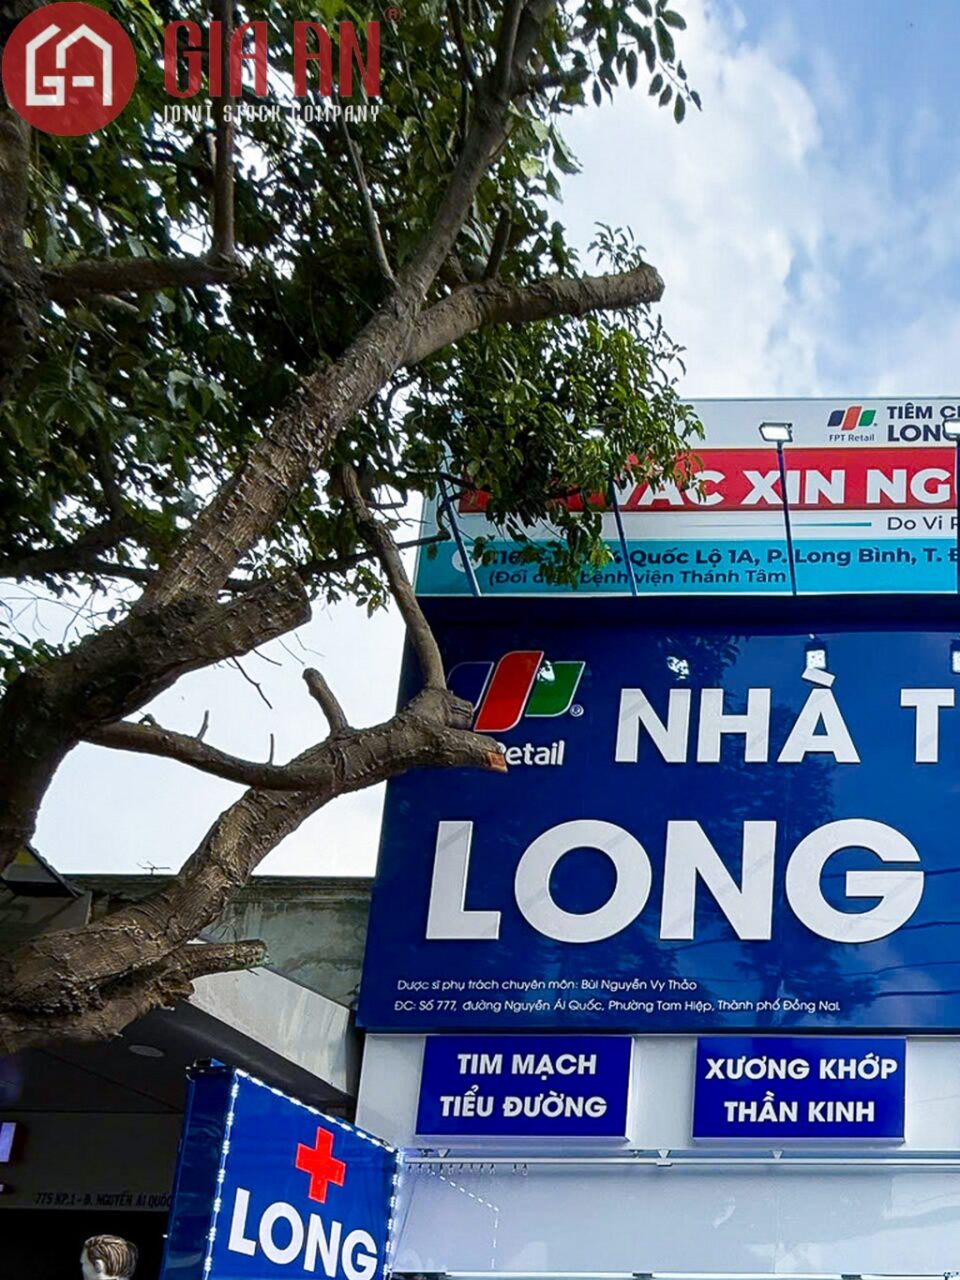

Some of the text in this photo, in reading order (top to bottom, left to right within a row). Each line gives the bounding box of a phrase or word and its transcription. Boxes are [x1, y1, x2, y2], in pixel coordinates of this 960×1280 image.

[887, 402, 933, 419] TIÊM
[829, 433, 875, 442] FPT Retail
[741, 469, 846, 505] XIN
[887, 516, 917, 531] Do
[922, 515, 943, 530] Vi
[629, 547, 692, 566] Quốc
[695, 548, 722, 568] Lộ
[728, 549, 760, 567] 1A,
[767, 549, 788, 564] P.
[795, 549, 851, 566] Long
[858, 546, 917, 566] Bình,
[923, 548, 942, 563] T.
[489, 569, 527, 587] (Đối
[580, 570, 629, 586] bệnh
[636, 570, 674, 586] viện
[679, 569, 740, 584] Thánh
[614, 667, 862, 763] NHÀ
[425, 818, 925, 944] LONG
[397, 979, 430, 991] Dược
[441, 979, 465, 992] phụ
[468, 979, 499, 990] trách
[501, 979, 545, 992] chuyên
[547, 979, 579, 990] môn:
[581, 979, 599, 990] Bùi
[600, 978, 647, 992] Nguyễn
[649, 979, 666, 992] Vy
[668, 978, 698, 991] Thảo
[394, 999, 416, 1011] ĐC:
[418, 998, 434, 1011] Số
[436, 999, 457, 1012] 777,
[462, 999, 501, 1013] đường
[504, 998, 551, 1013] Nguyễn
[553, 998, 566, 1011] Ái
[568, 997, 605, 1012] Quốc,
[608, 999, 654, 1013] Phường
[656, 1000, 682, 1011] Tam
[684, 1000, 715, 1013] Hiệp,
[717, 999, 753, 1011] Thành
[756, 997, 781, 1013] phố
[783, 999, 816, 1013] Đồng
[457, 1053, 598, 1081] TIM MẠCH
[704, 1052, 899, 1080] XƯƠNG KHỚP
[440, 1084, 608, 1118] TIỂU ĐƯỜNG
[724, 1089, 876, 1123] THẦN KINH
